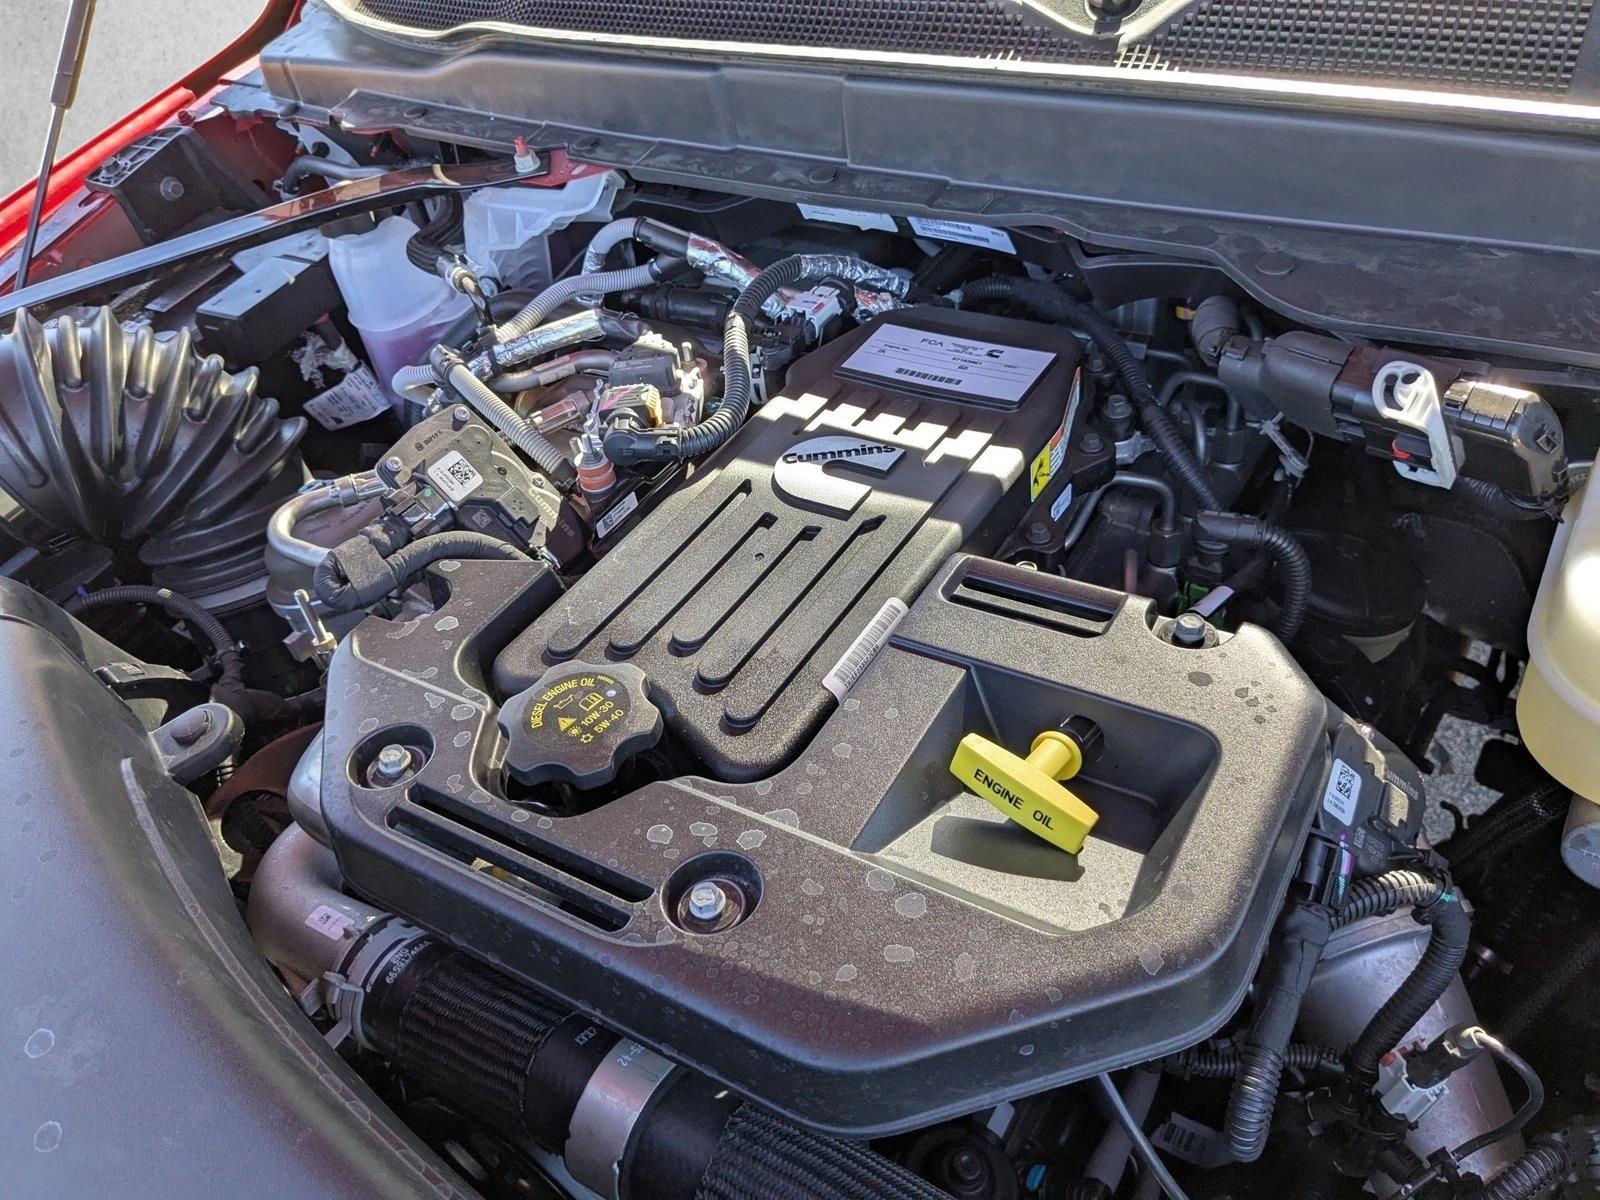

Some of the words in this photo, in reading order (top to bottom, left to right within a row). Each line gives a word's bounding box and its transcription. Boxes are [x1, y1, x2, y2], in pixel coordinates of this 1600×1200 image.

[921, 338, 943, 347] FCA
[782, 444, 896, 464] Cummins
[530, 700, 548, 729] DIESEL
[542, 679, 578, 701] ENGINE
[580, 677, 595, 687] OIL
[581, 701, 614, 726] 10W-30
[594, 709, 624, 733] 5W-40
[1383, 767, 1419, 800] ummins
[973, 768, 1024, 810] ENGINE
[1032, 809, 1054, 831] OIL
